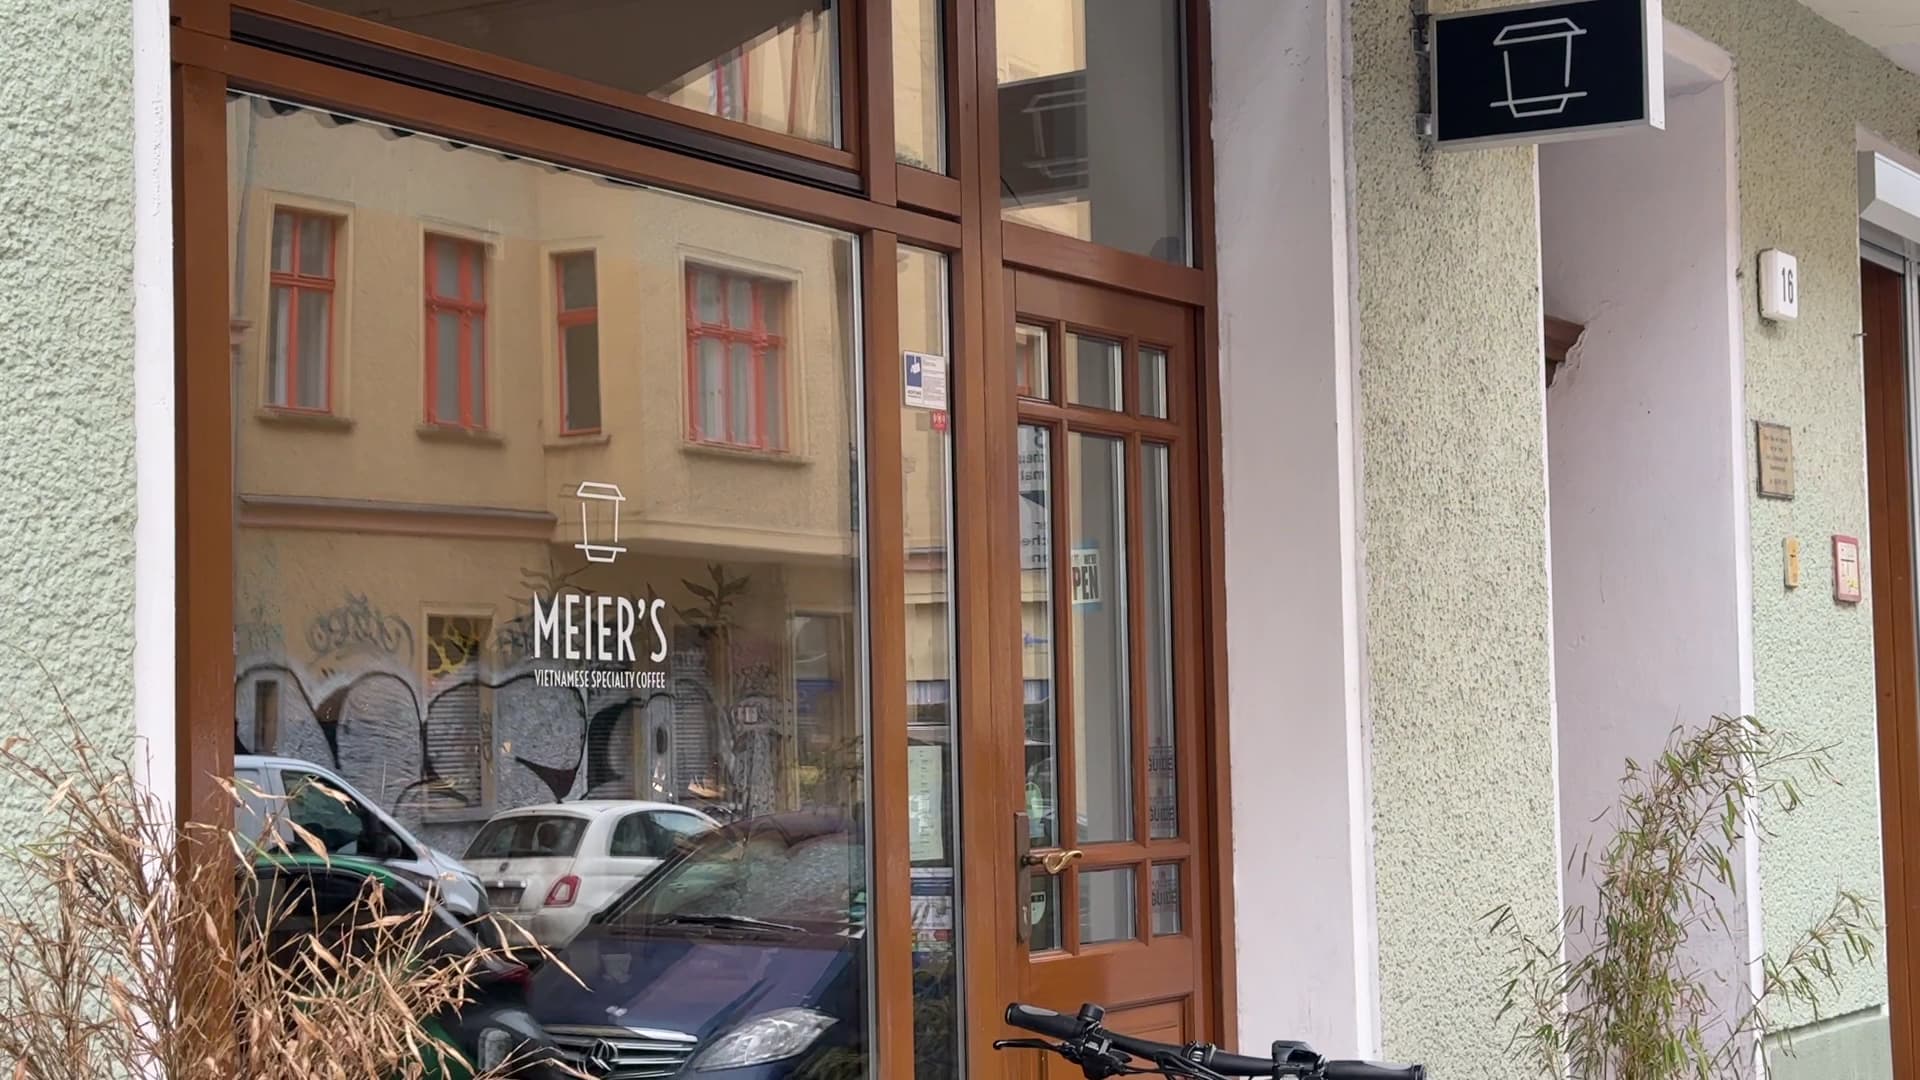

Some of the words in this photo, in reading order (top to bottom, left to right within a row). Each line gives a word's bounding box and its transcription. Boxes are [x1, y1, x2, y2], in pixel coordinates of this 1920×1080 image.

[1782, 267, 1794, 305] 16
[1072, 566, 1098, 600] PEN
[534, 591, 667, 662] MEIER'S
[534, 669, 589, 688] VIETNAMESE
[591, 670, 635, 688] SPECIALTY
[636, 672, 665, 688] COFFEE
